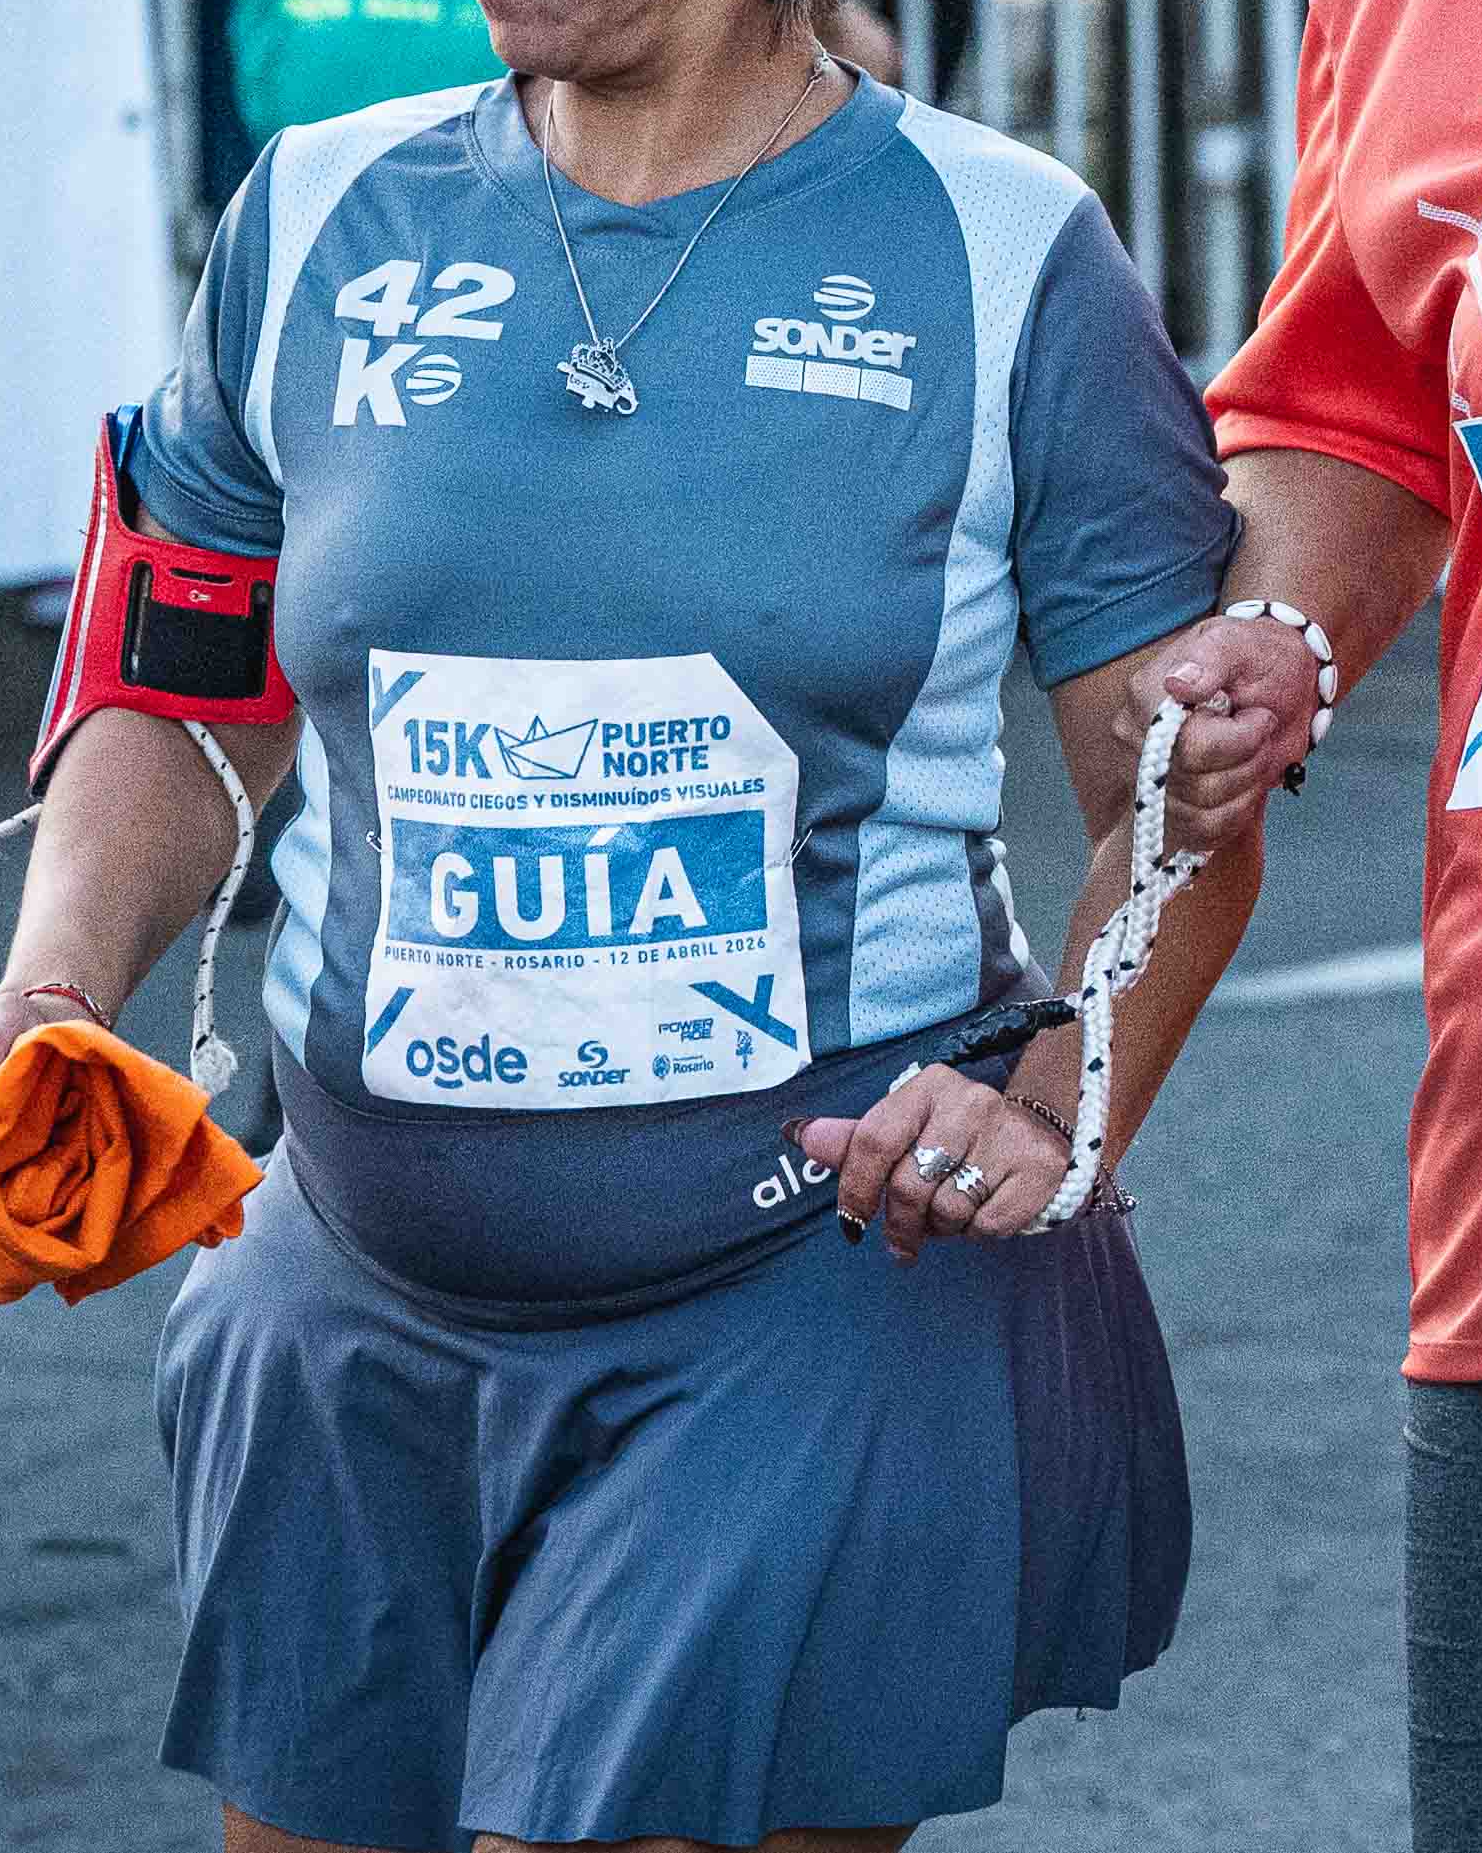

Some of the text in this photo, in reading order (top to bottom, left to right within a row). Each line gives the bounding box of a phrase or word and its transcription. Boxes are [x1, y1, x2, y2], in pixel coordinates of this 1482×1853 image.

[334, 258, 516, 341] 42
[404, 717, 493, 780] 15K
[601, 715, 731, 749] PUERTO
[602, 745, 710, 779] NORTE
[387, 784, 466, 808] CAMPEONATO
[470, 794, 528, 810] CIEGOS
[533, 793, 546, 809] Y
[676, 777, 765, 802] VISUALES
[429, 826, 708, 941] GUÍA
[384, 945, 431, 964] PUERTO
[436, 951, 484, 969] NORTE
[504, 954, 585, 970] ROSARIO
[609, 951, 630, 965] 12
[638, 949, 660, 964] DE
[667, 942, 718, 961] ABRIL
[725, 936, 766, 954] 2026
[673, 1059, 714, 1074] Rosario
